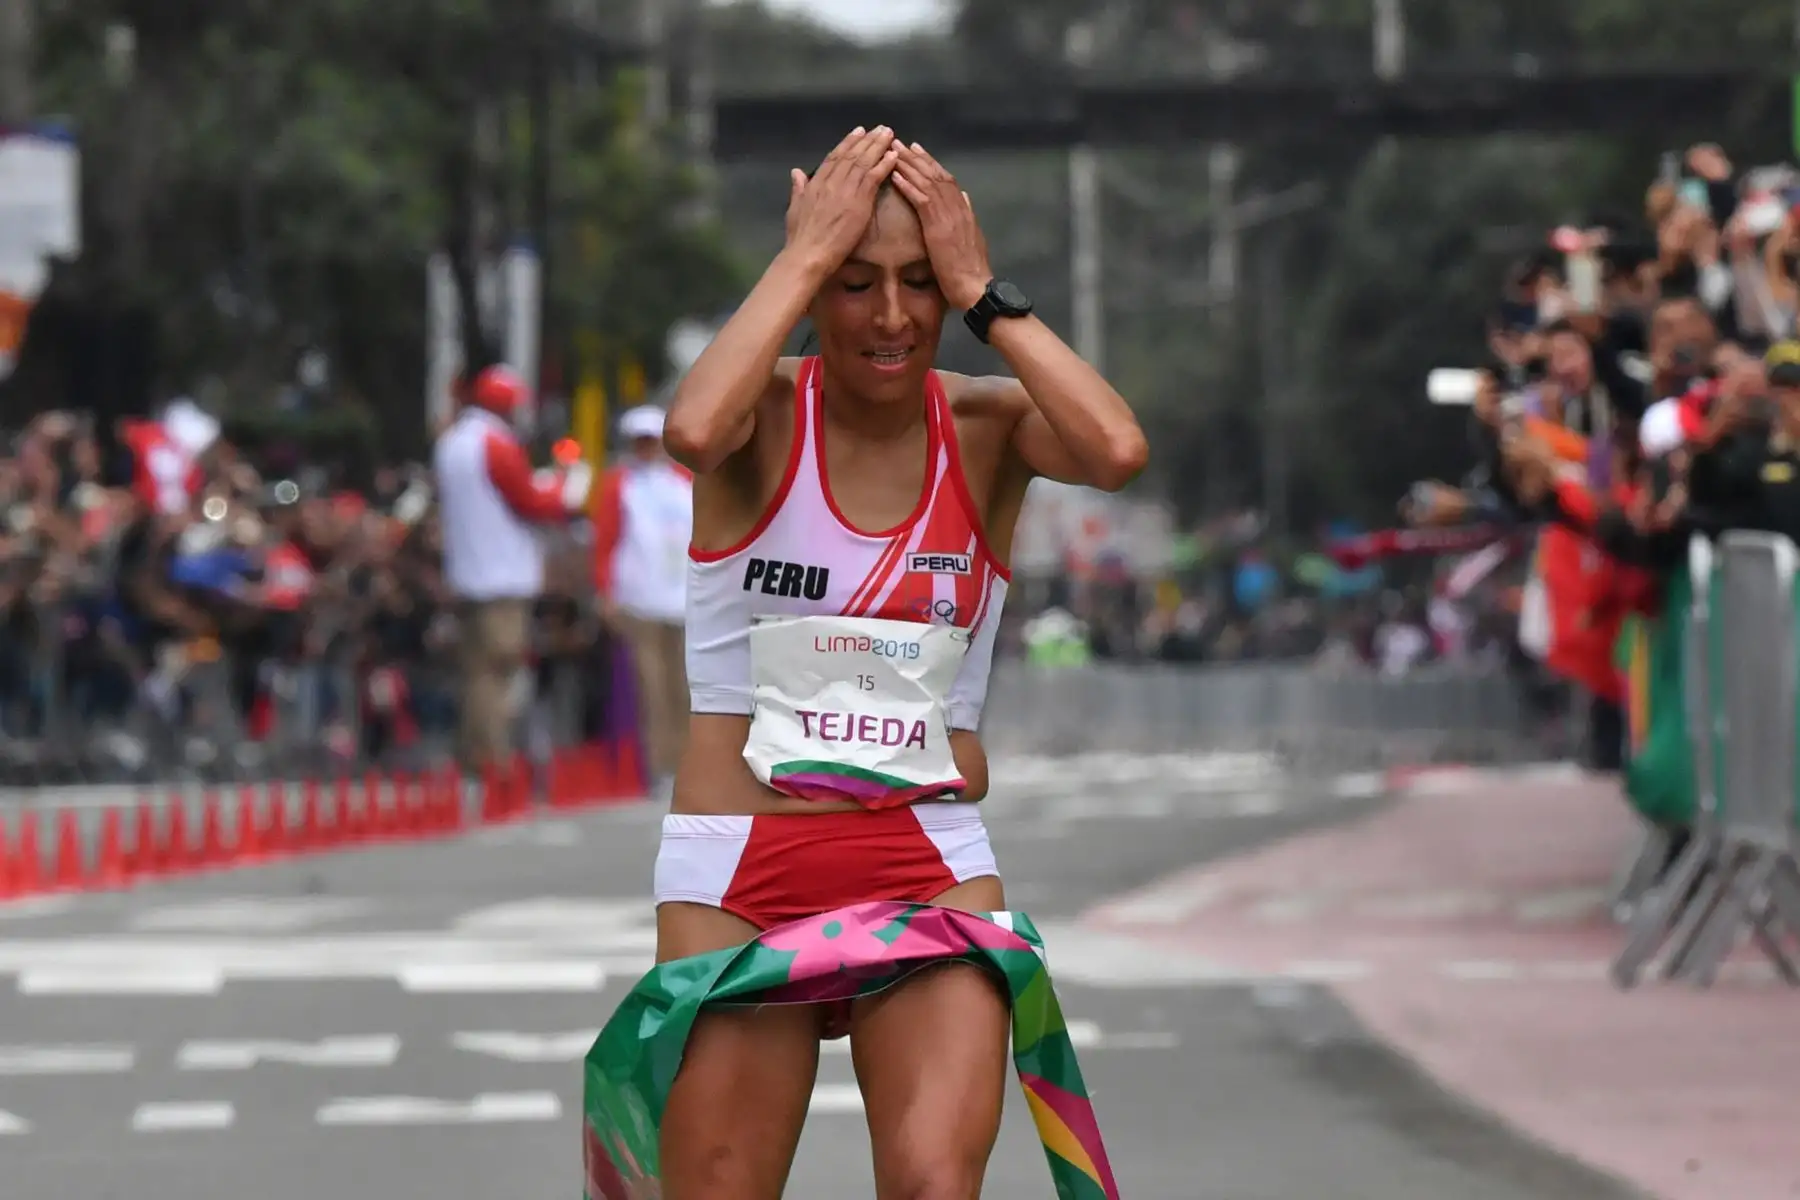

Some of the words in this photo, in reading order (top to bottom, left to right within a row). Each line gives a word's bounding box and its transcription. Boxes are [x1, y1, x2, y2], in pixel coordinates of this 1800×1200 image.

[912, 556, 968, 572] PERU
[743, 558, 829, 600] PERU
[856, 674, 876, 691] 15
[795, 710, 926, 749] TEJEDA
